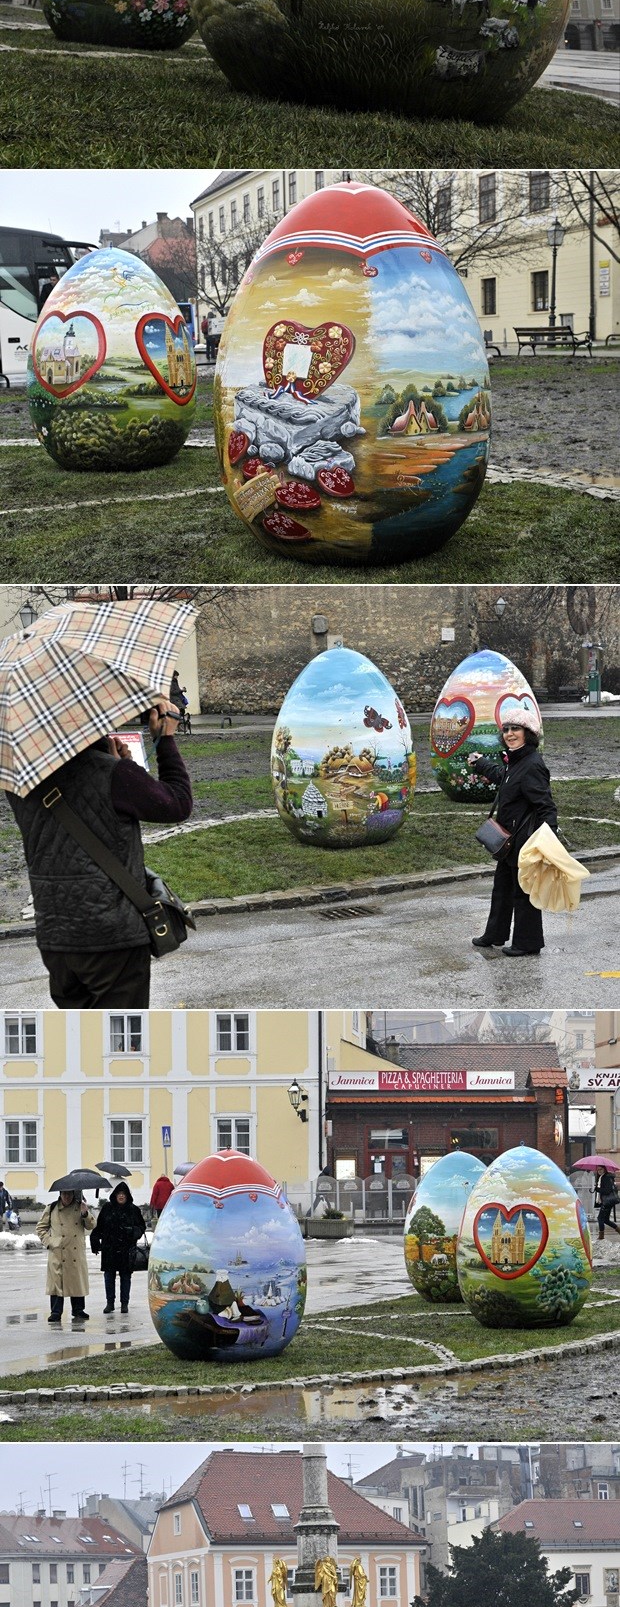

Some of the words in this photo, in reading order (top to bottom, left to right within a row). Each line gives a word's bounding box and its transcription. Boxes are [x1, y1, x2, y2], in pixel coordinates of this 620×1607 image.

[331, 1075, 375, 1086] Jamnica
[381, 1072, 403, 1084] PIZZA
[404, 1072, 411, 1084] &
[412, 1072, 464, 1084] SPAGHETTERIA
[469, 1075, 512, 1086] Jamnica
[587, 1078, 604, 1087] SV.
